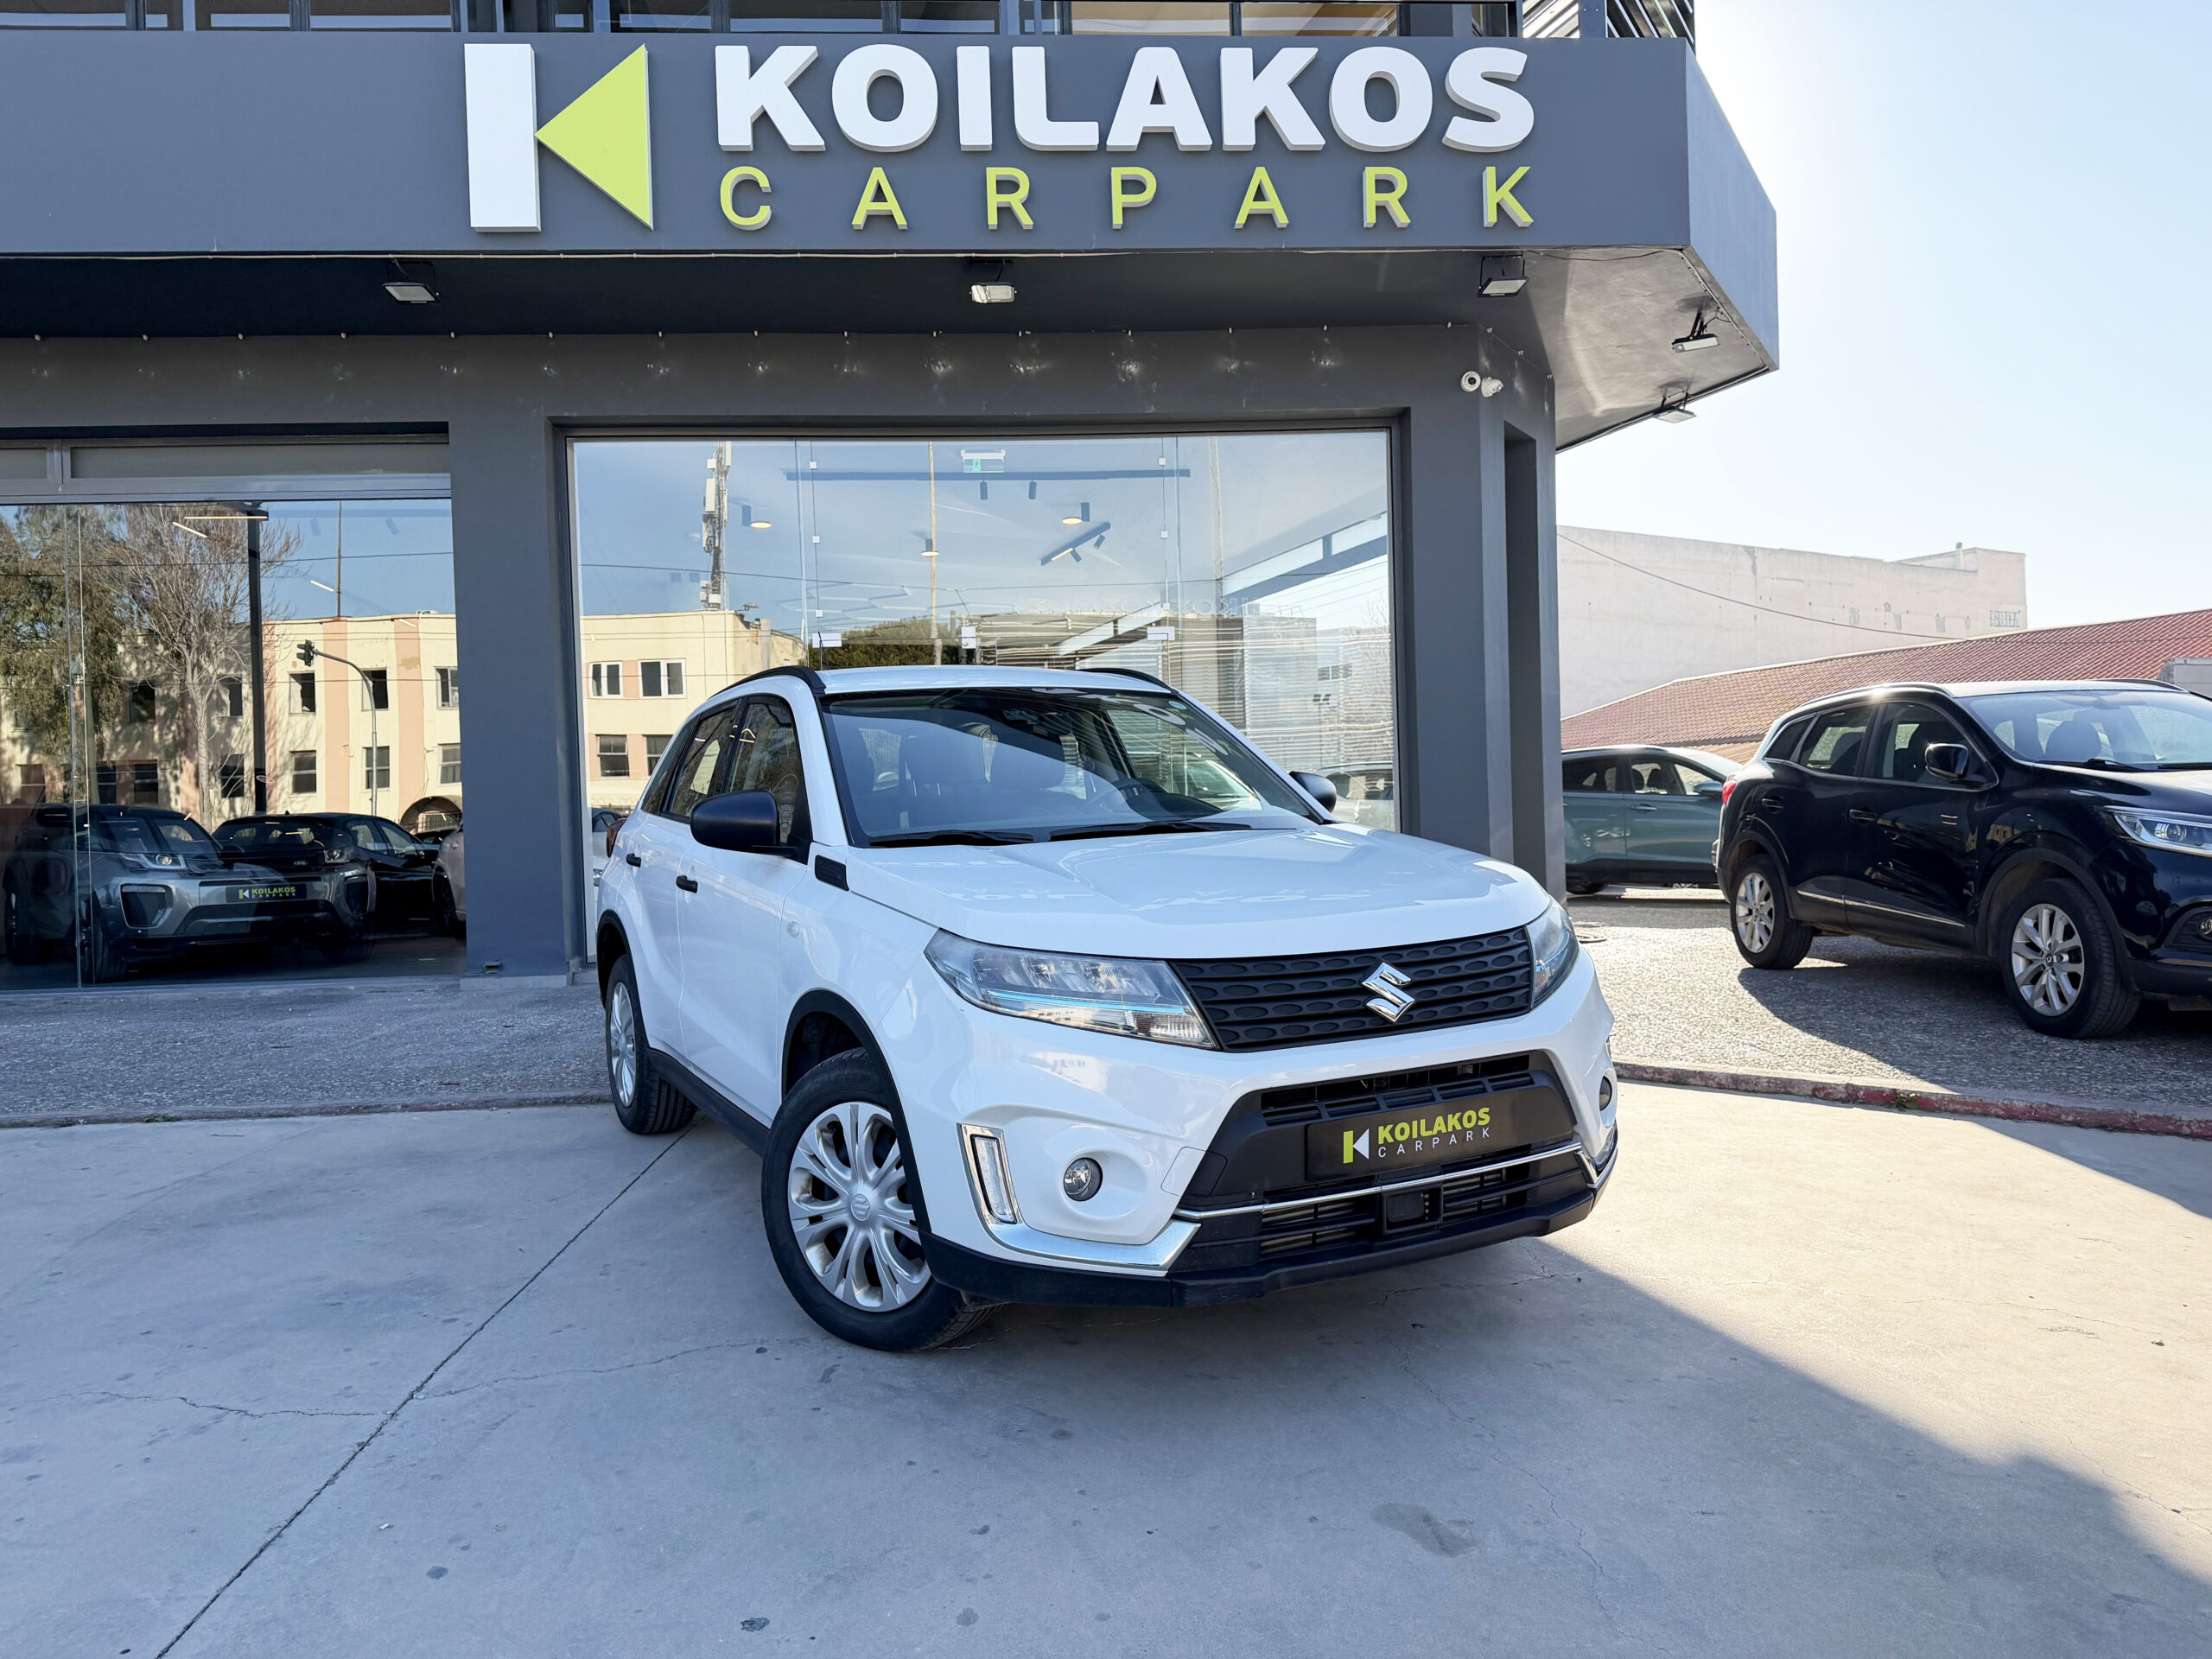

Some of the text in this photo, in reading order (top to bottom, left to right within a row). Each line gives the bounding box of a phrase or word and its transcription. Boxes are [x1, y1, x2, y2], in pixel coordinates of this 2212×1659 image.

[715, 44, 1535, 153] KOILAKOS
[719, 165, 1534, 231] CARPARK
[251, 886, 296, 895] KOILAKOS
[1377, 1107, 1491, 1145] KOILAKOS
[1377, 1127, 1491, 1159] CARPARK
